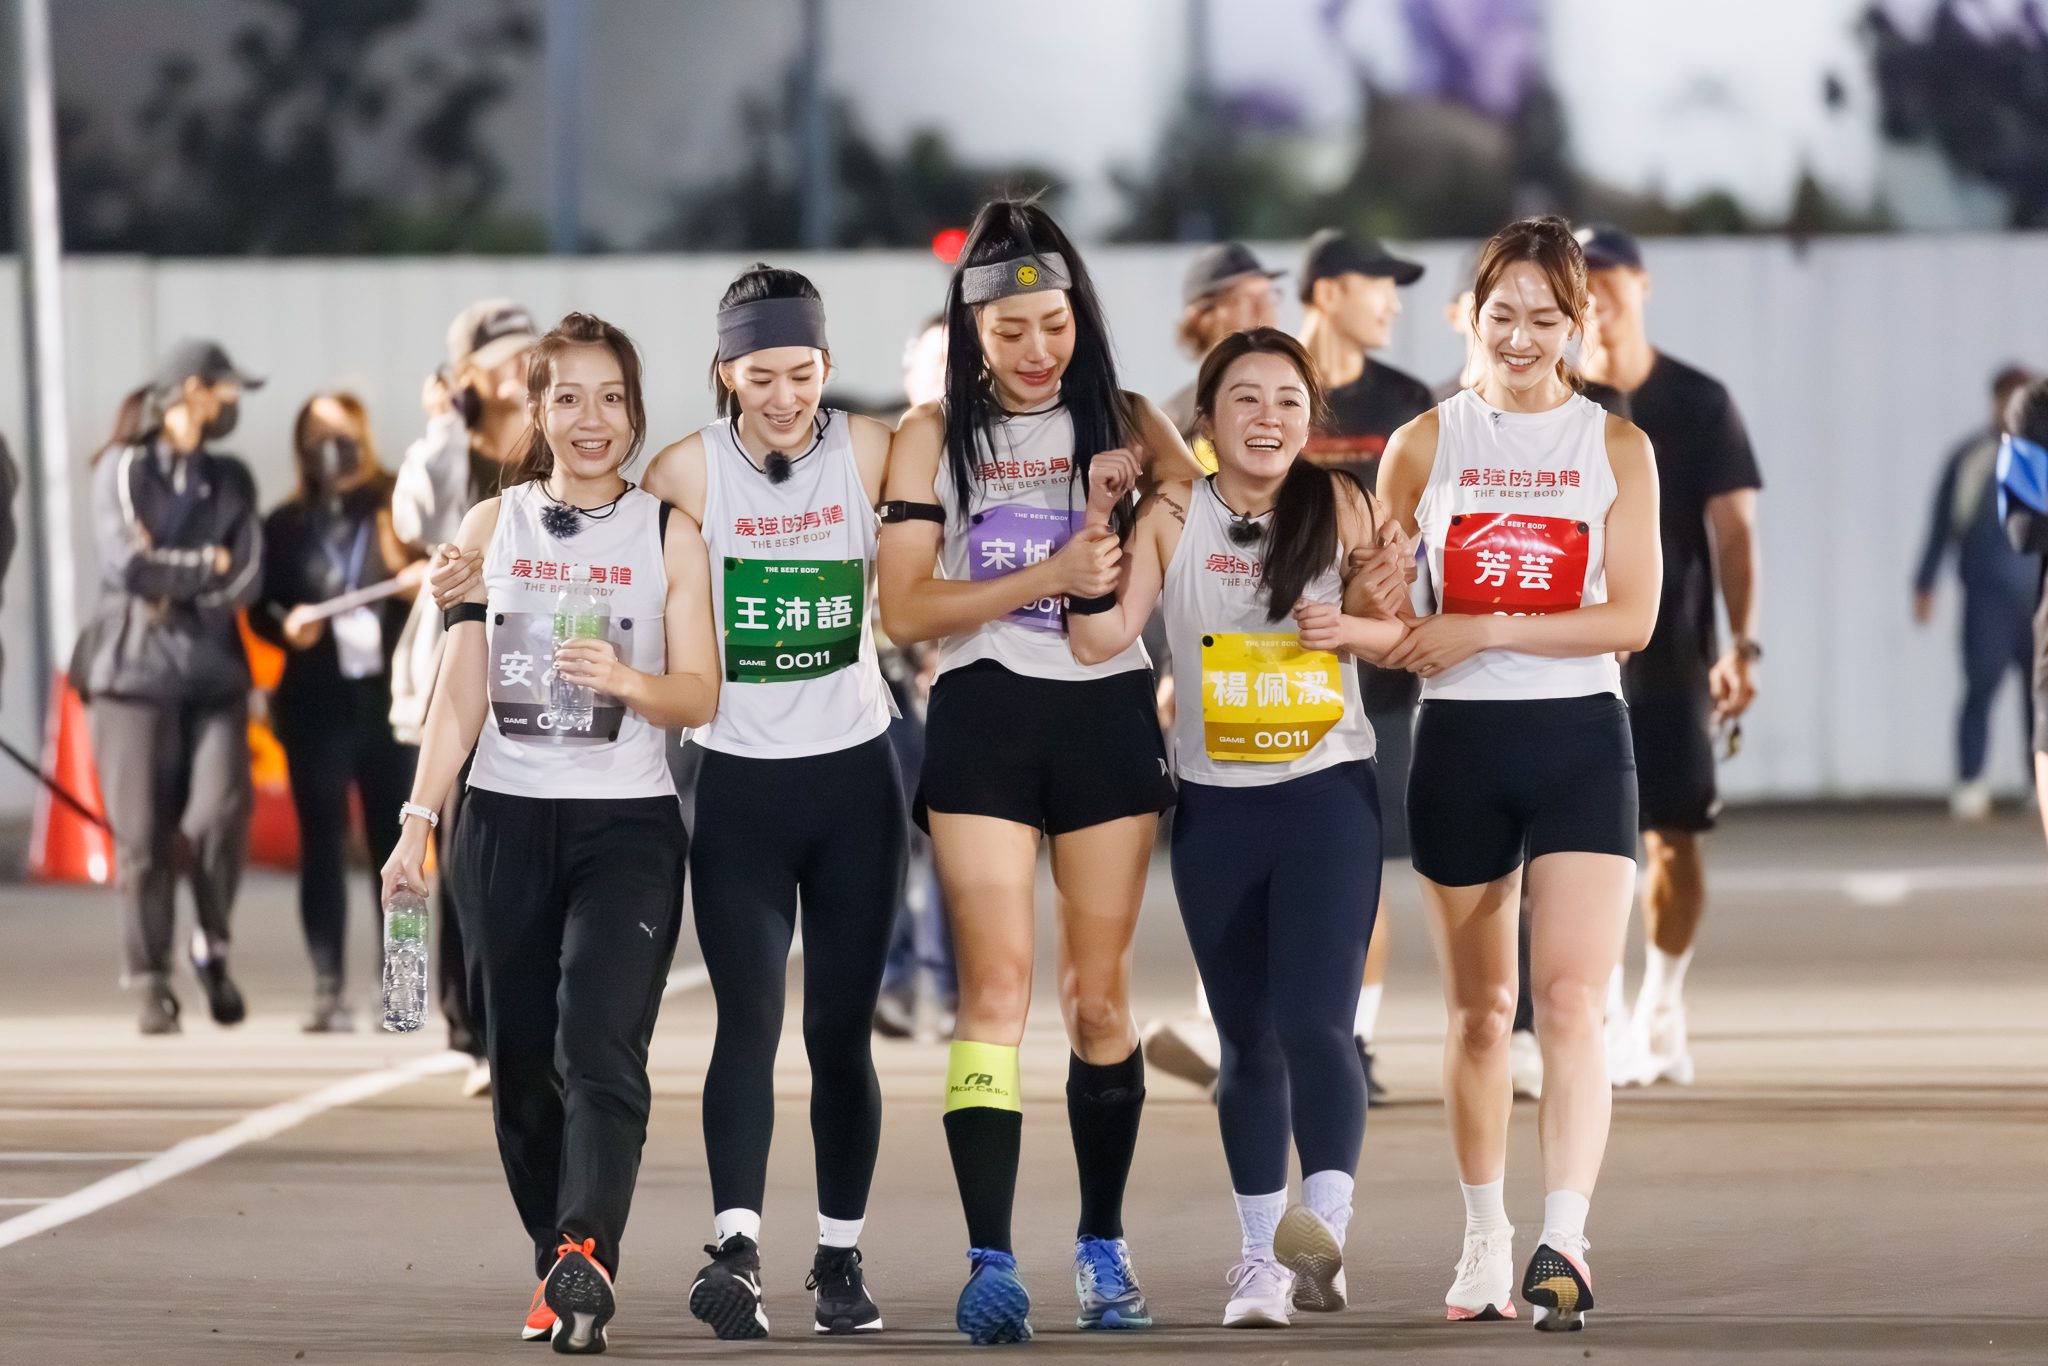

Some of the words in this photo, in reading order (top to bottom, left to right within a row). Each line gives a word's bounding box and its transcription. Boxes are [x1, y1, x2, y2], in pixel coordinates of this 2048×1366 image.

[975, 456, 1071, 481] 最強的身
[1459, 468, 1581, 487] 最強的身體
[992, 483, 1015, 491] THE
[1018, 479, 1047, 488] BEST
[1474, 490, 1496, 498] THE
[1500, 489, 1529, 498] BEST
[1533, 488, 1565, 498] BODY
[735, 504, 845, 536] 最強的身體
[1030, 512, 1049, 520] BEST
[1507, 520, 1527, 528] BEST
[1527, 522, 1547, 530] BODY
[751, 540, 773, 549] THE
[775, 535, 801, 548] BEST
[803, 529, 832, 543] BODY
[1474, 549, 1554, 591] 芳芸
[524, 582, 546, 592] THE
[1220, 577, 1241, 587] THE
[734, 595, 853, 631] 王沛語
[738, 659, 767, 667] GAME
[776, 650, 831, 670] 0011
[1212, 670, 1332, 708] 楊佩潔
[503, 716, 528, 725] GAME
[1219, 735, 1246, 744] GAME
[1254, 729, 1310, 748] 0011
